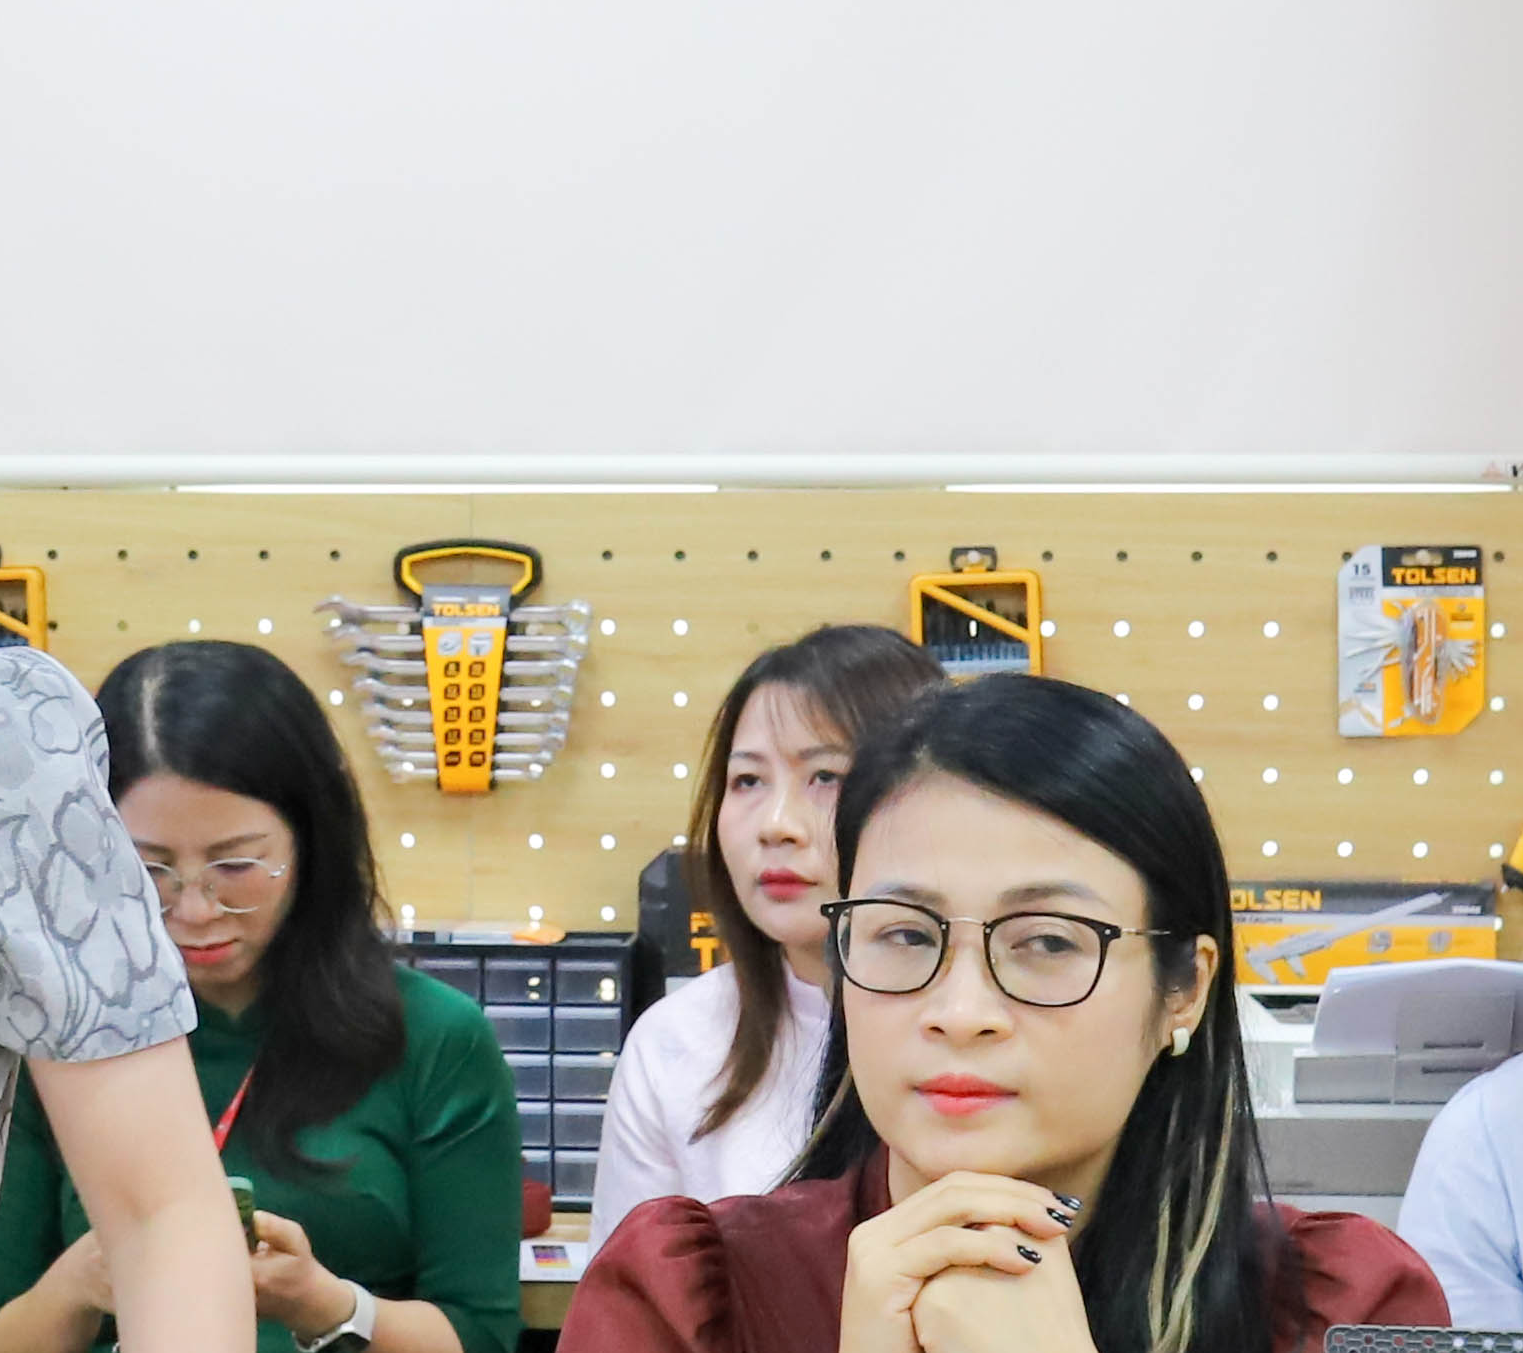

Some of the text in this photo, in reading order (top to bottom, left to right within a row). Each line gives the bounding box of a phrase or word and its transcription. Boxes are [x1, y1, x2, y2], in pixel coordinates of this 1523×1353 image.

[1354, 563, 1371, 576] 15
[1391, 567, 1477, 585] TOLSEN
[432, 603, 501, 617] TOLSEN
[1230, 889, 1322, 911] OLSEN
